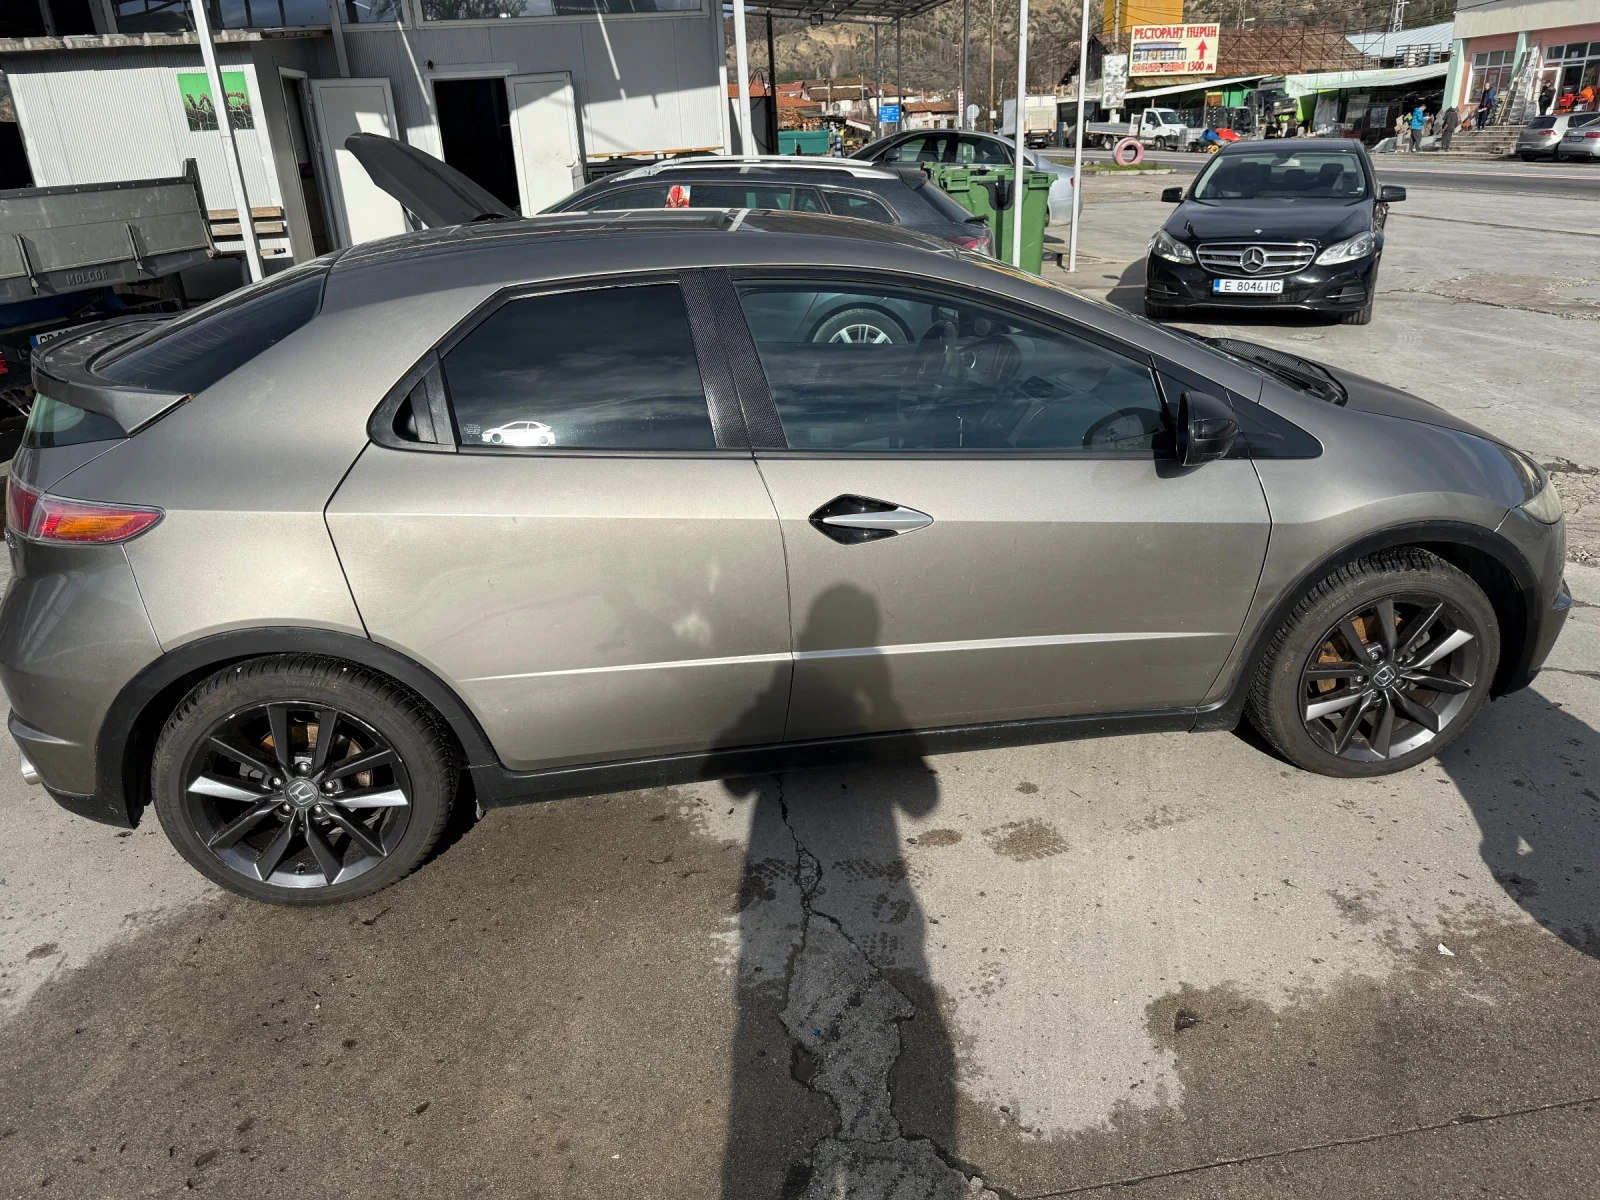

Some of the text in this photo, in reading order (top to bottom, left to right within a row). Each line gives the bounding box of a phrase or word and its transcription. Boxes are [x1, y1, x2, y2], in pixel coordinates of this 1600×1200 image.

[1134, 27, 1184, 39] РЕСТОРАНТ
[1187, 61, 1204, 71] 1300
[66, 269, 108, 285] MOLCOR
[1236, 281, 1263, 291] 8046
